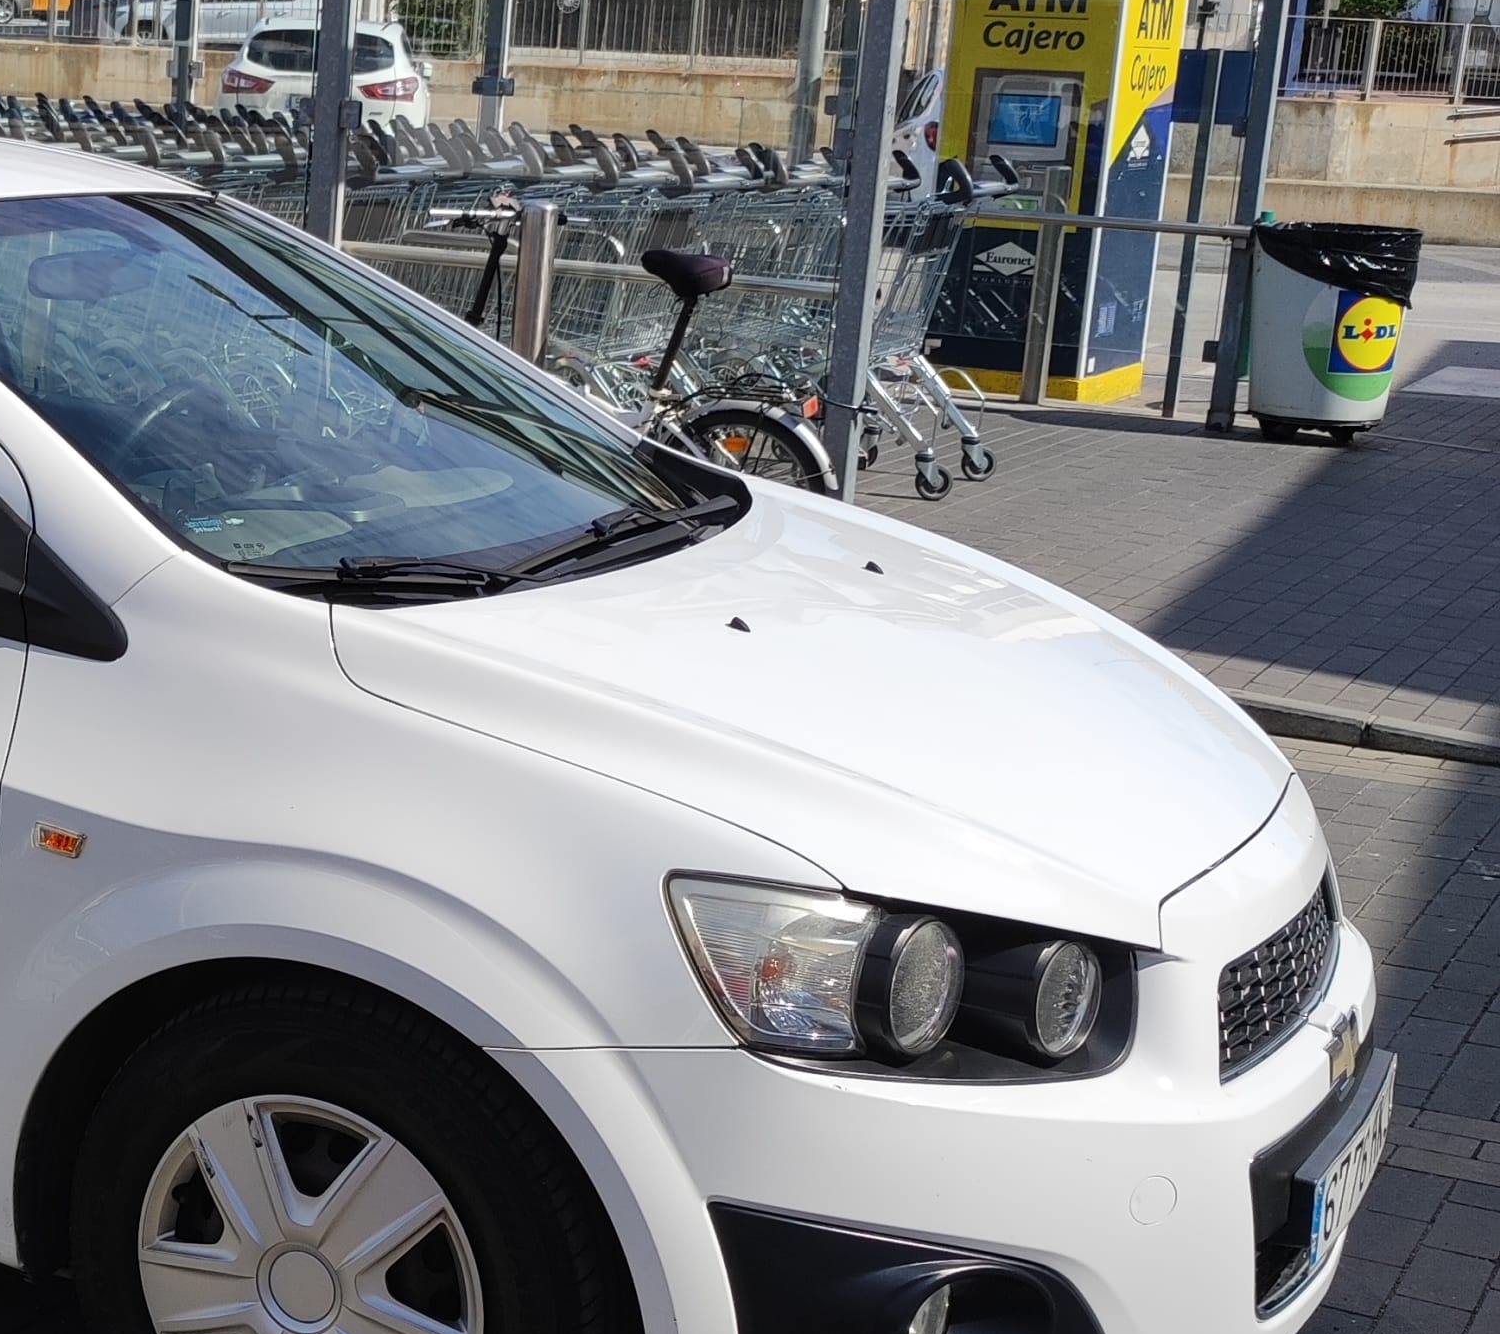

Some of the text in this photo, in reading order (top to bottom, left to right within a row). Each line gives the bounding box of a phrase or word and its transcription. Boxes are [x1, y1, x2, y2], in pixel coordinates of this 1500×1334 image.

[983, 21, 1086, 55] Cajero
[1130, 54, 1166, 99] Cajero
[985, 252, 1033, 266] Euronet
[1324, 1128, 1369, 1241] 6776
